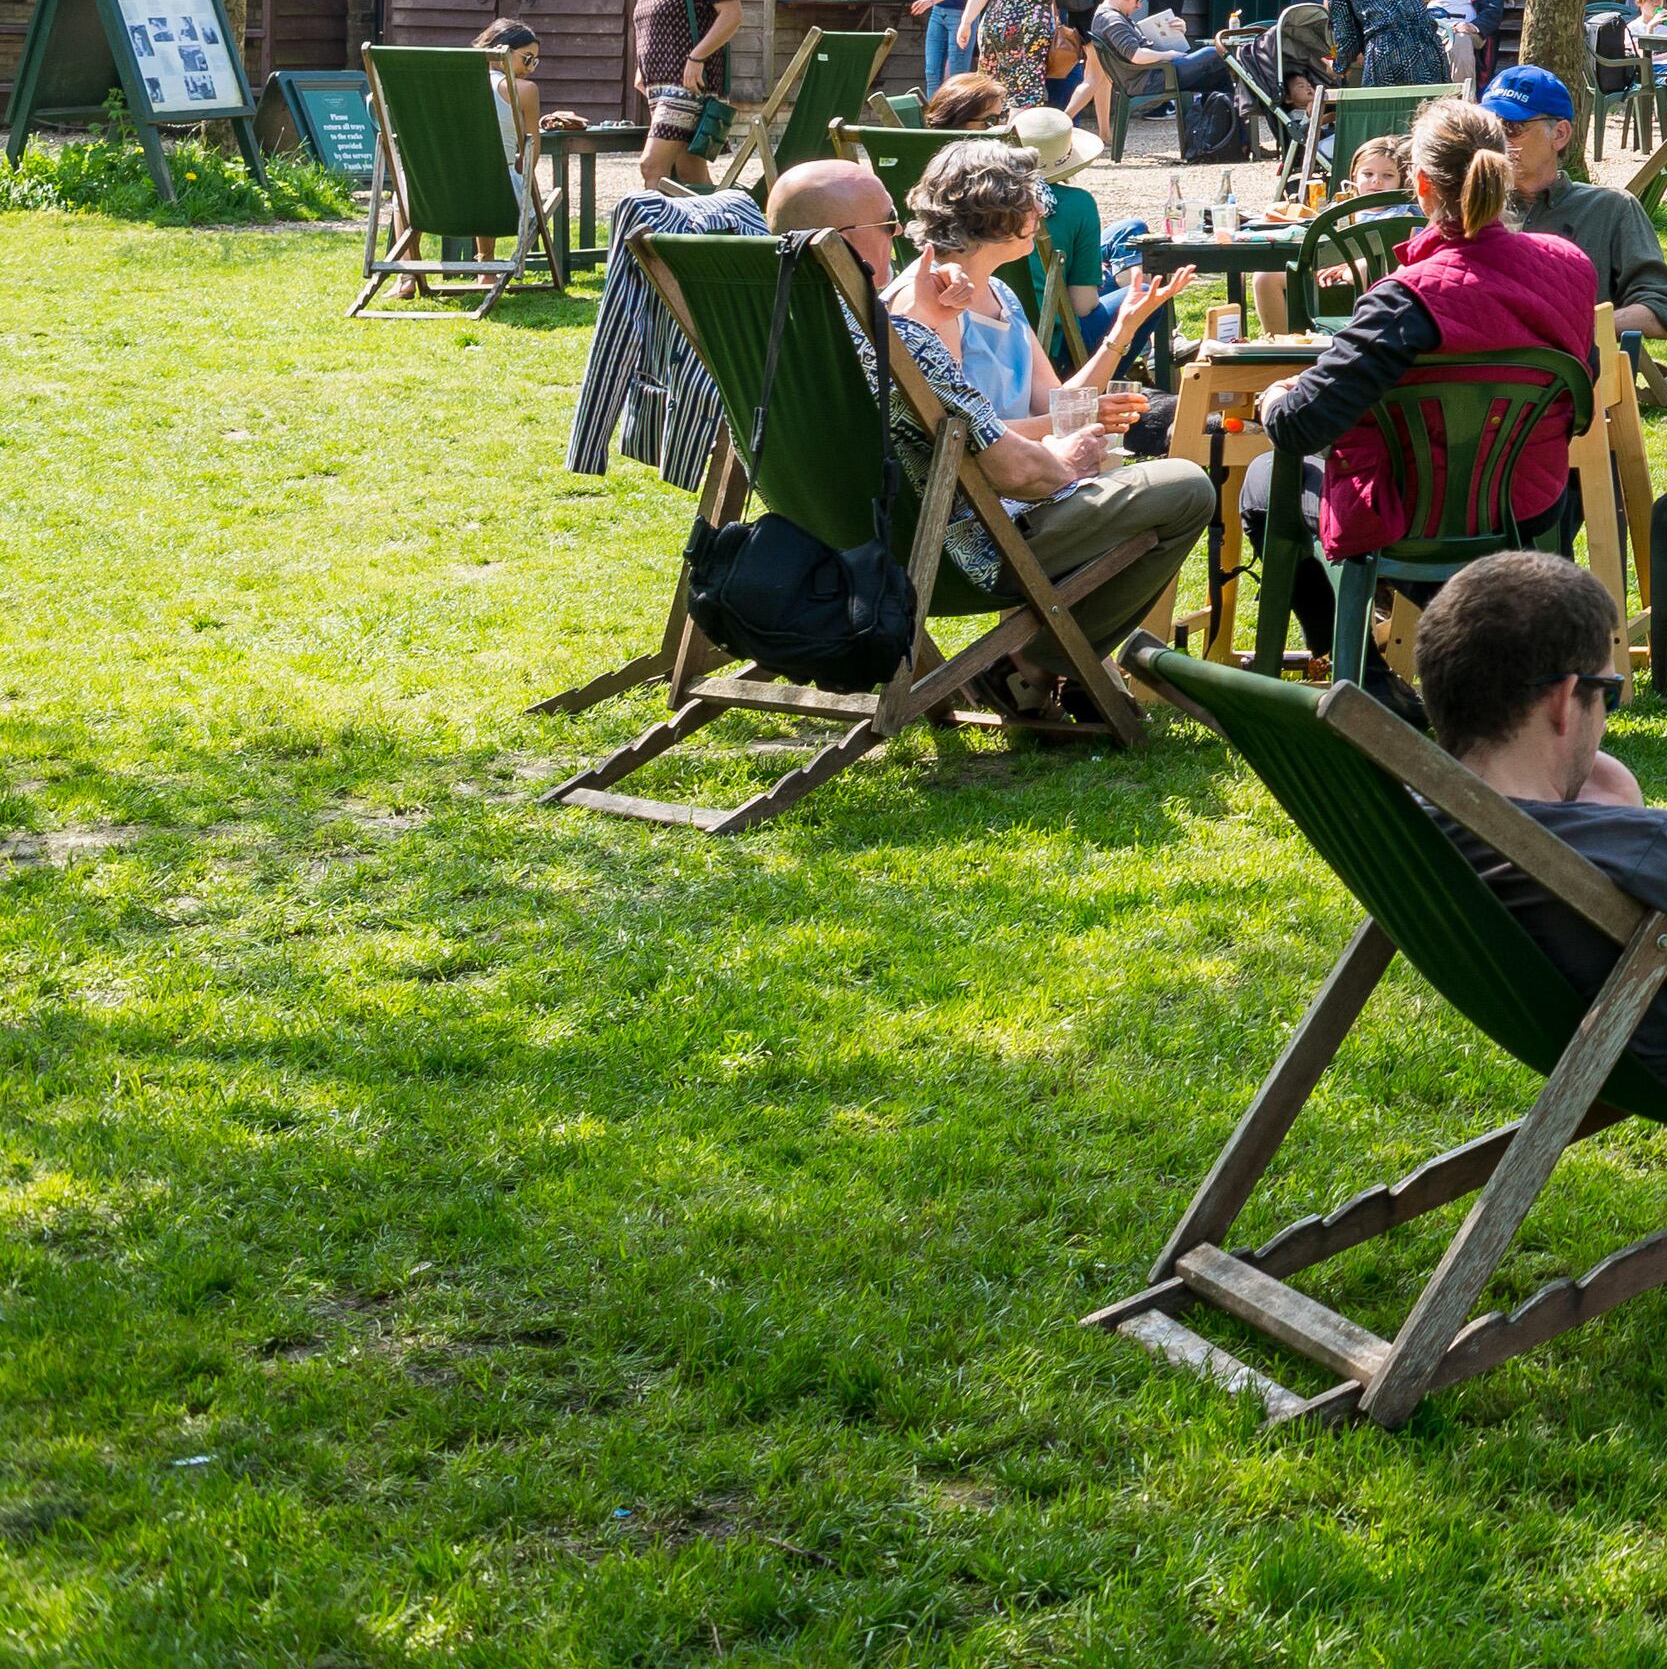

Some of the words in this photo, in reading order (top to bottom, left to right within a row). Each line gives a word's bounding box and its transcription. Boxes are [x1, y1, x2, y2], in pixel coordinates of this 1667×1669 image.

[329, 113, 348, 121] Please
[350, 124, 365, 132] trays
[337, 142, 362, 151] provided
[334, 152, 342, 160] by
